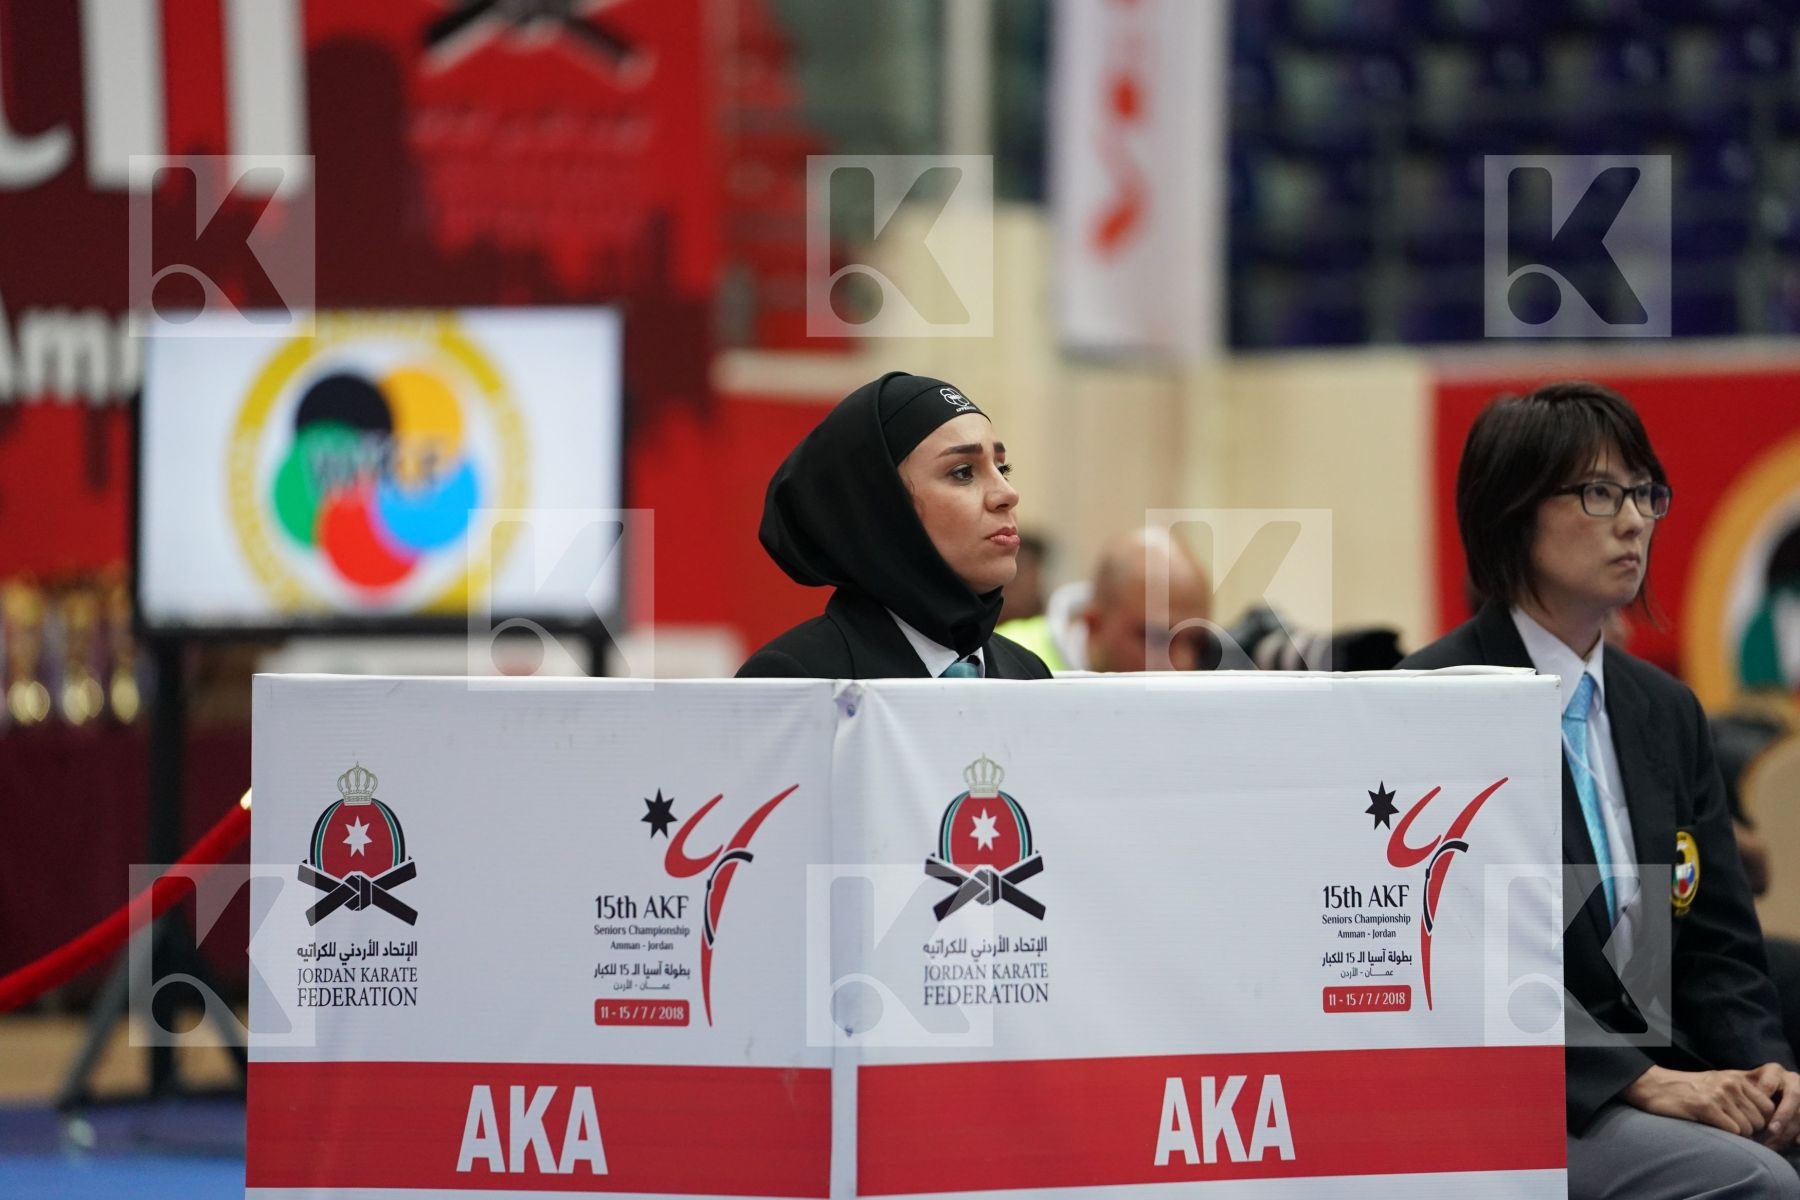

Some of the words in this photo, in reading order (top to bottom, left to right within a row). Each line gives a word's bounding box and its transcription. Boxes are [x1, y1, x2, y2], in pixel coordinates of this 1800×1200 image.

[1322, 884, 1362, 909] 15th
[1368, 884, 1410, 908] AKF
[594, 895, 637, 919] 15th
[643, 895, 689, 919] AKF
[1322, 914, 1353, 925] Seniors
[1354, 913, 1411, 926] Championship
[593, 924, 626, 936] Seniors
[628, 924, 691, 938] Championship
[1337, 929, 1366, 939] Amman
[1372, 928, 1397, 940] Jordan
[339, 939, 379, 965] الأردني
[610, 940, 641, 951] Amman
[647, 940, 674, 952] Jordan
[1322, 951, 1344, 967] للكبار
[1346, 951, 1355, 964] 15
[1388, 950, 1412, 966] بطولة
[297, 967, 356, 986] JORDAN
[360, 967, 418, 983] KARATE
[594, 962, 617, 979] للكبار
[619, 963, 630, 976] 15
[664, 963, 690, 980] بطولة
[924, 963, 987, 984] JORDAN
[992, 962, 1049, 980] KARATE
[297, 987, 418, 1007] FEDERATION
[924, 983, 1049, 1006] FEDERATION
[1383, 992, 1406, 1005] 2018
[659, 1006, 685, 1020] 2018
[1153, 1074, 1296, 1167] AKA
[456, 1084, 609, 1176] AKA
